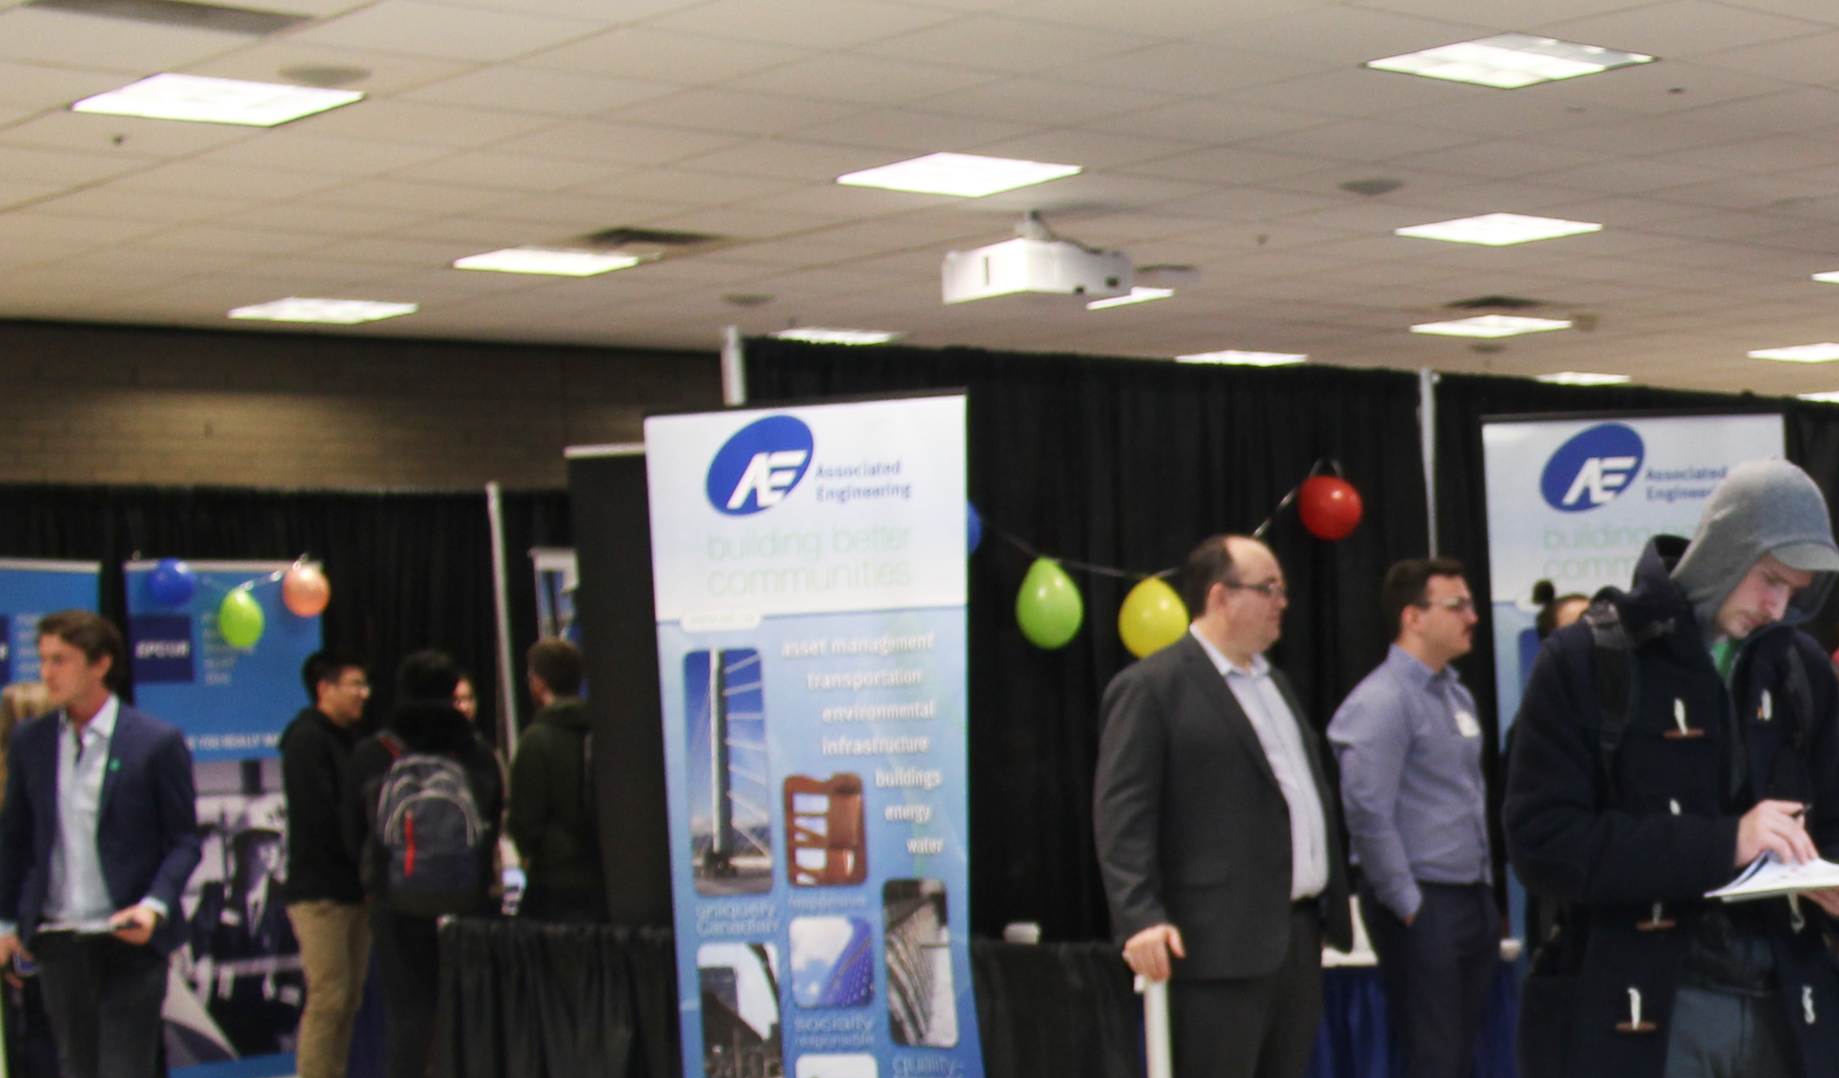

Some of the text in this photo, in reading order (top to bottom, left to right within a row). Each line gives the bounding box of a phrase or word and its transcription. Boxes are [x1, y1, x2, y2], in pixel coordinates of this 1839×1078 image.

[726, 450, 808, 509] AE
[815, 461, 901, 480] Associated
[1562, 456, 1638, 506] AE
[1646, 466, 1727, 481] Associated
[816, 483, 912, 503] Engineering
[705, 523, 913, 562] building better
[706, 558, 913, 597] communities
[782, 631, 936, 657] asset management
[807, 669, 922, 691] transportation
[821, 700, 935, 722] environmental
[821, 735, 930, 756] infrastructure
[875, 767, 942, 791] buildings
[884, 804, 930, 824] energy
[906, 837, 944, 854] water
